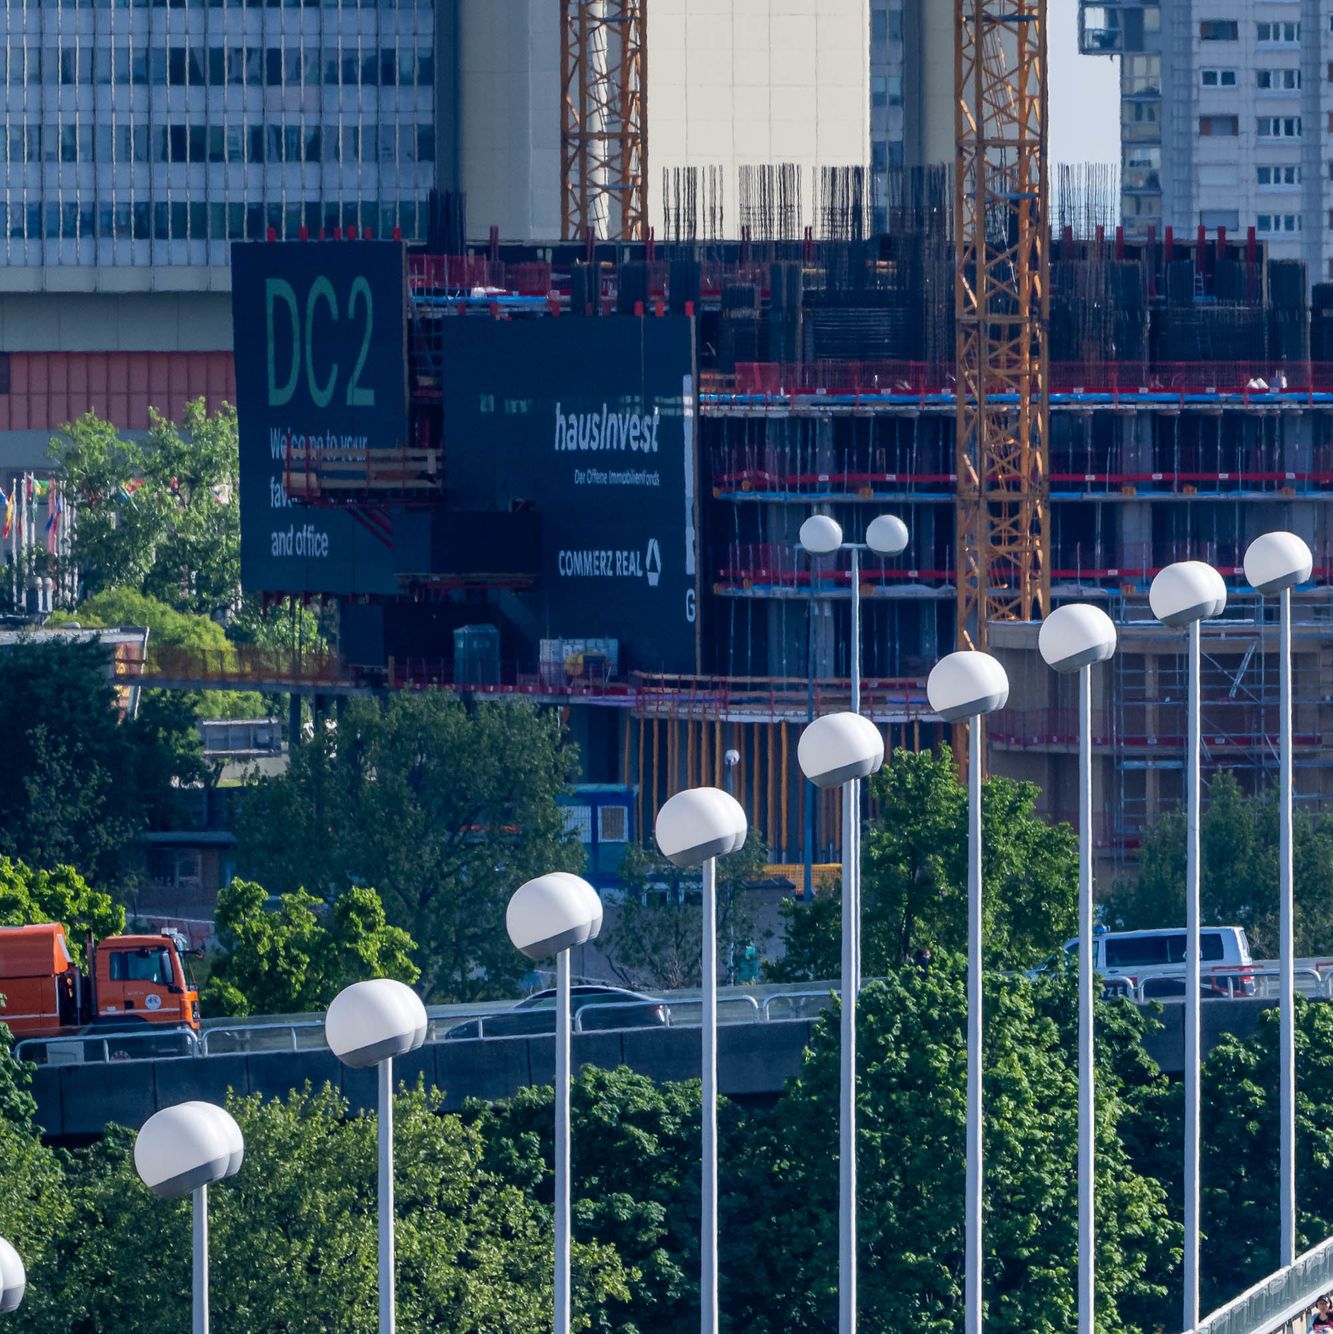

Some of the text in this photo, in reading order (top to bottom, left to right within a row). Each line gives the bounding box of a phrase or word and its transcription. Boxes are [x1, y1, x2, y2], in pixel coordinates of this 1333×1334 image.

[555, 402, 660, 452] hausInvest
[574, 468, 586, 484] Der
[271, 524, 329, 557] and office
[558, 550, 644, 577] COMMERZ REAL
